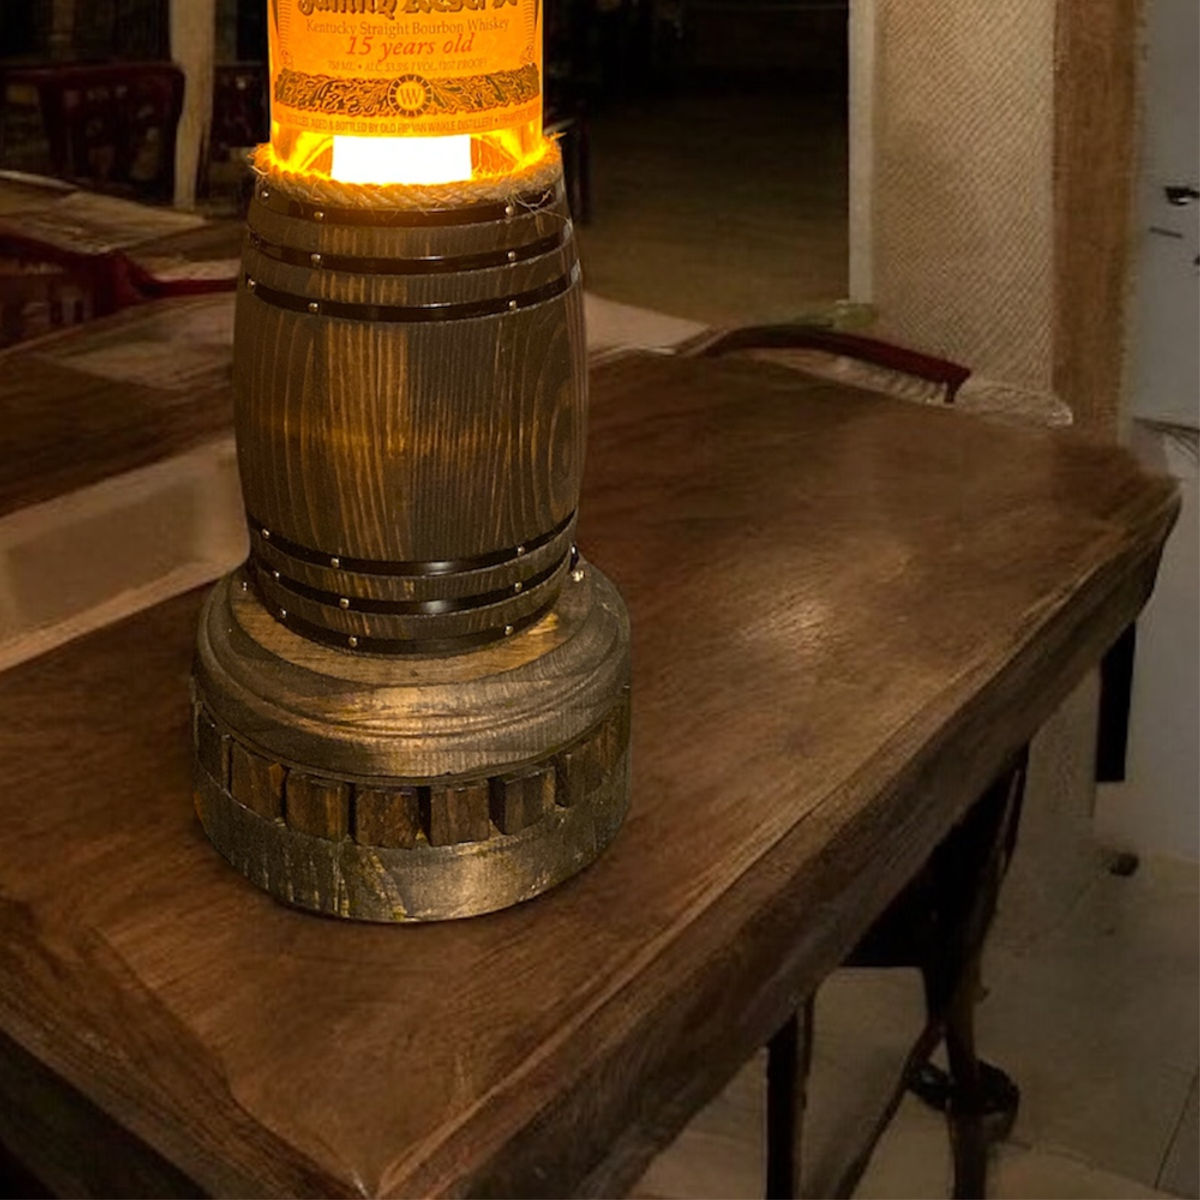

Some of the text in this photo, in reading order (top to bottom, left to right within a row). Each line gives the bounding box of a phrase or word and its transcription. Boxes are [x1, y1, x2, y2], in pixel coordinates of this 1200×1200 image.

[306, 16, 510, 39] Kentucky Straight Bourbon Whiskey
[345, 32, 476, 64] 15 years old
